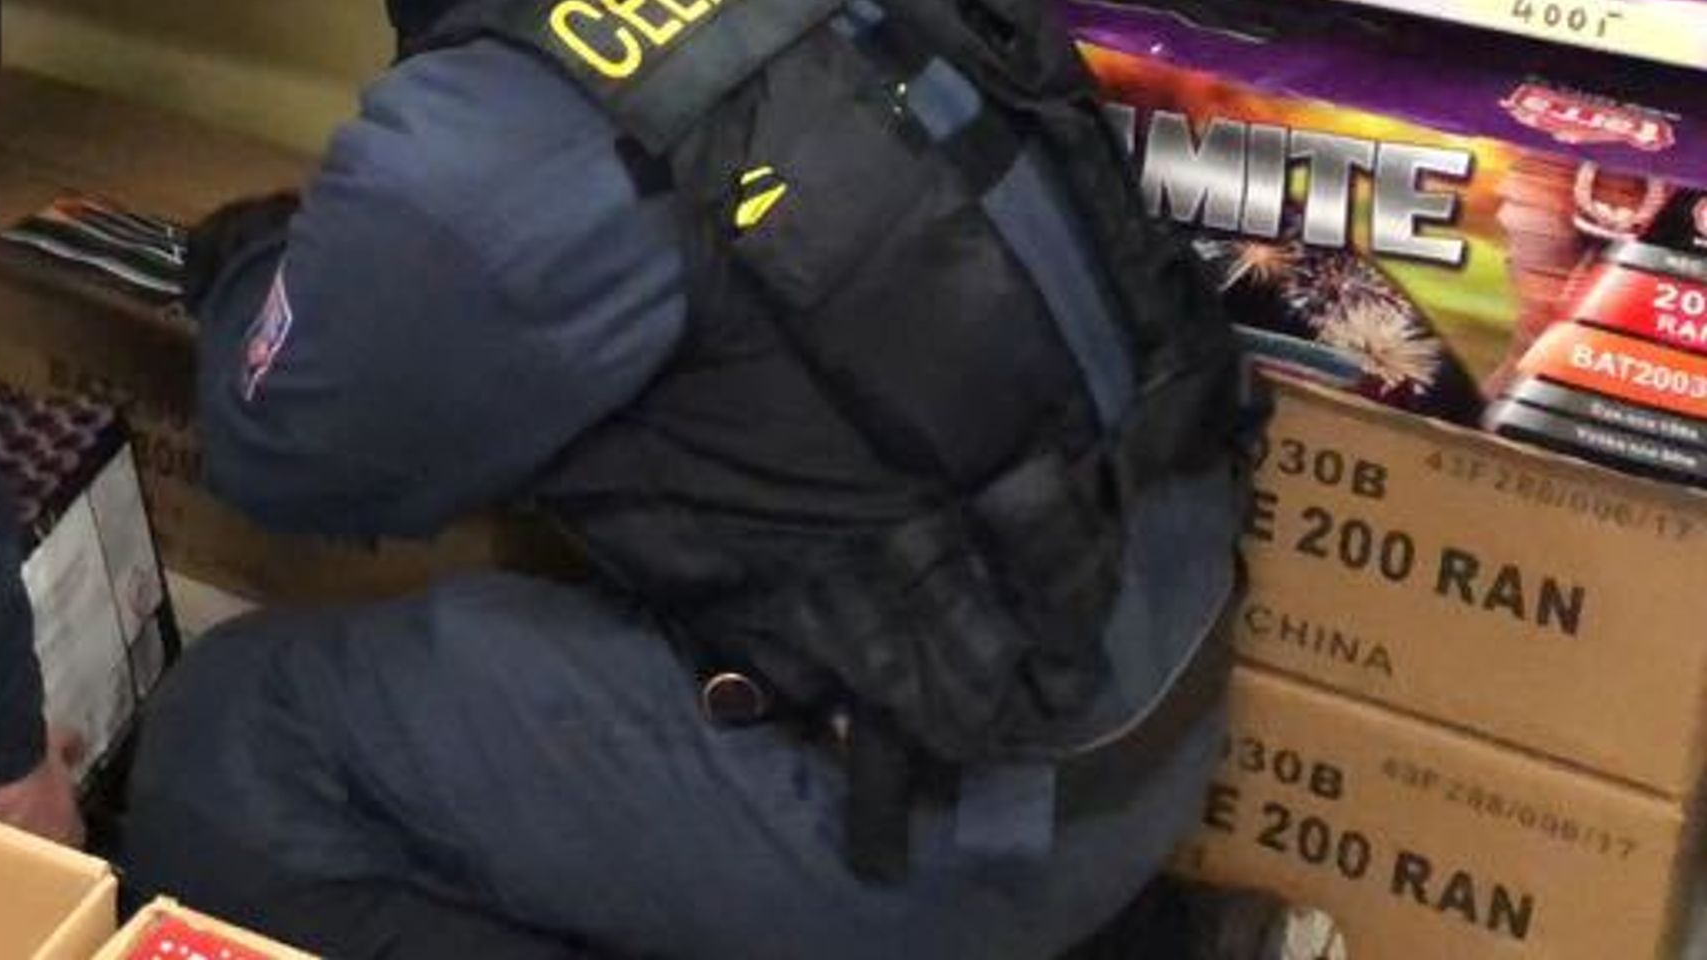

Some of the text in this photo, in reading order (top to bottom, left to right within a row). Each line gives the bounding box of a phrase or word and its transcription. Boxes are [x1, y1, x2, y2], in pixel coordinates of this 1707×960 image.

[1653, 283, 1706, 315] 20
[1657, 314, 1707, 343] RA
[1295, 505, 1415, 582] 200
[1436, 546, 1585, 637] RAN
[1244, 604, 1392, 677] CHINA
[1257, 801, 1371, 880] 200
[1390, 850, 1534, 940] RAN
